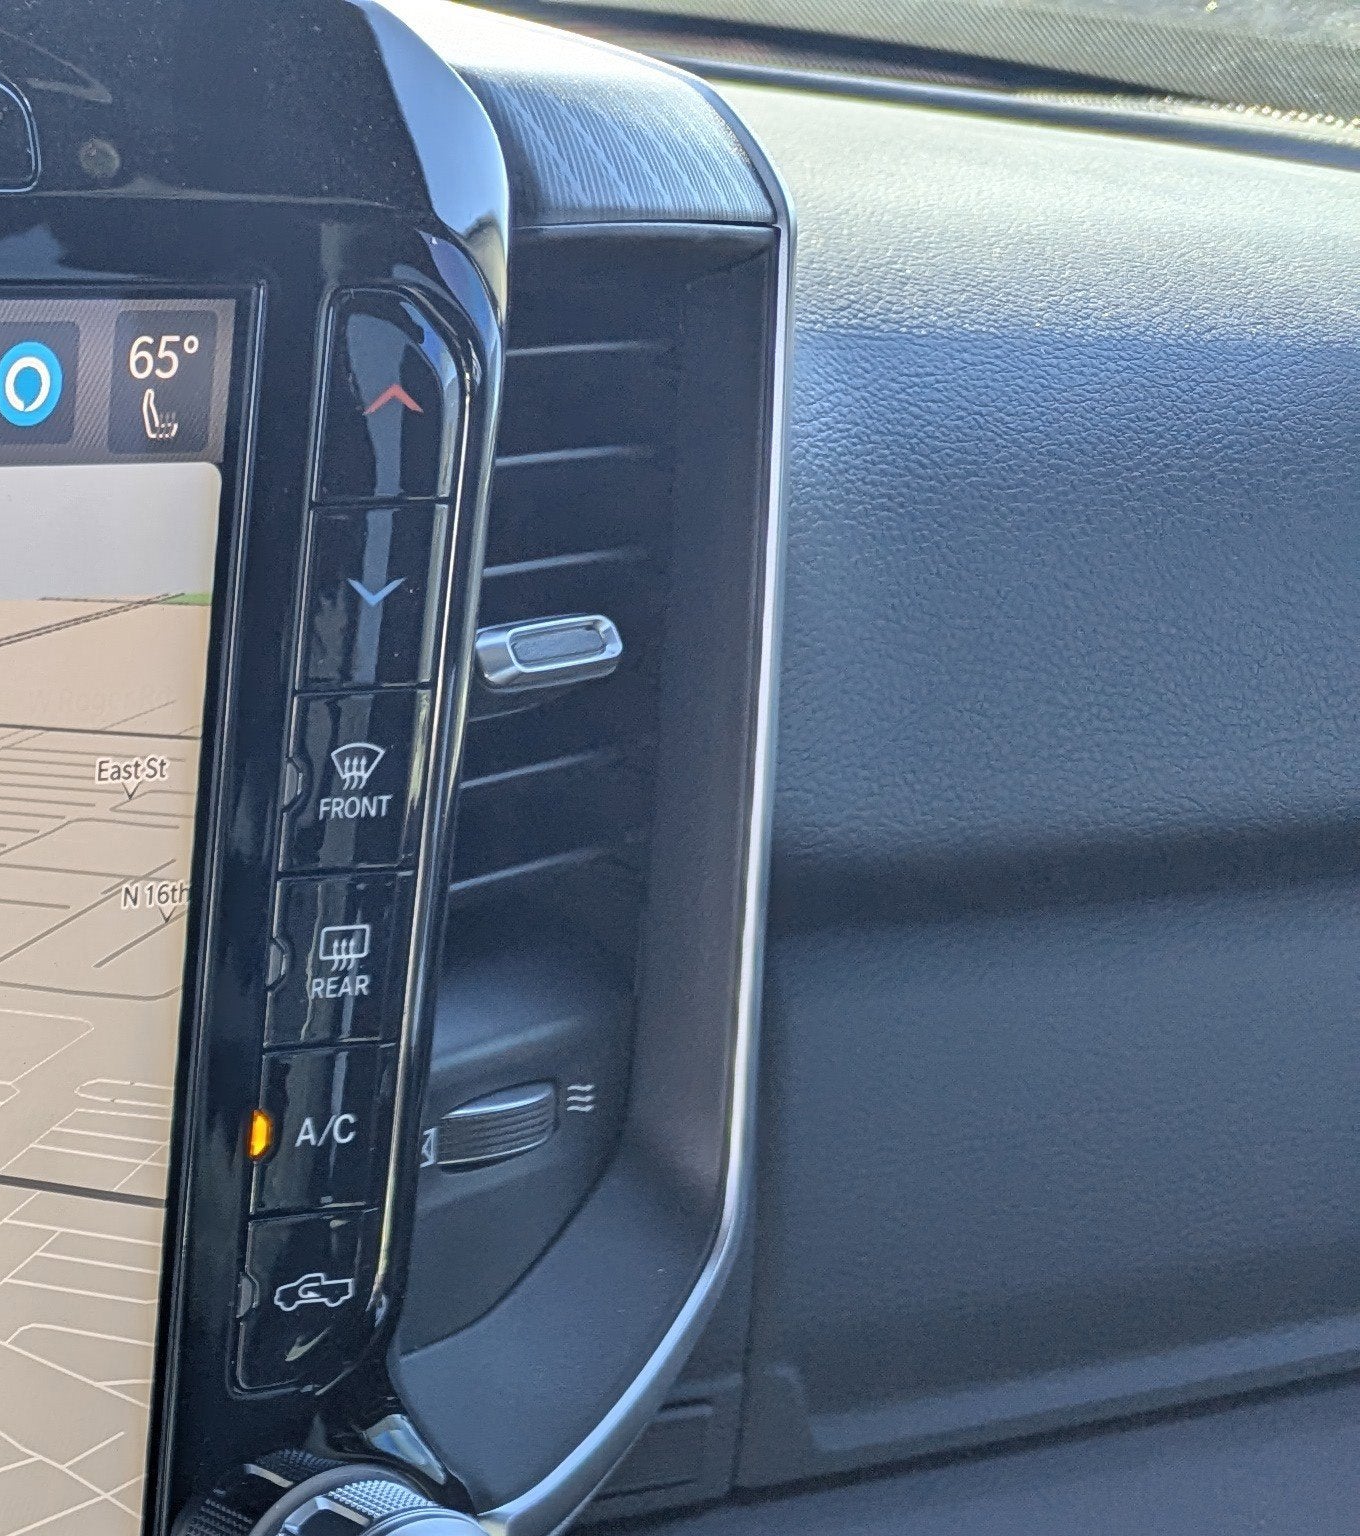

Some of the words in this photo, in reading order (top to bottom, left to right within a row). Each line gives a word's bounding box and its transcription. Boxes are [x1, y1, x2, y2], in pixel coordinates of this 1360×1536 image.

[128, 335, 200, 379] 65°
[98, 759, 140, 782] East
[145, 758, 168, 779] St
[318, 795, 392, 819] FRONT
[122, 886, 139, 908] N
[311, 975, 370, 999] REAR
[295, 1114, 357, 1147] A/C
